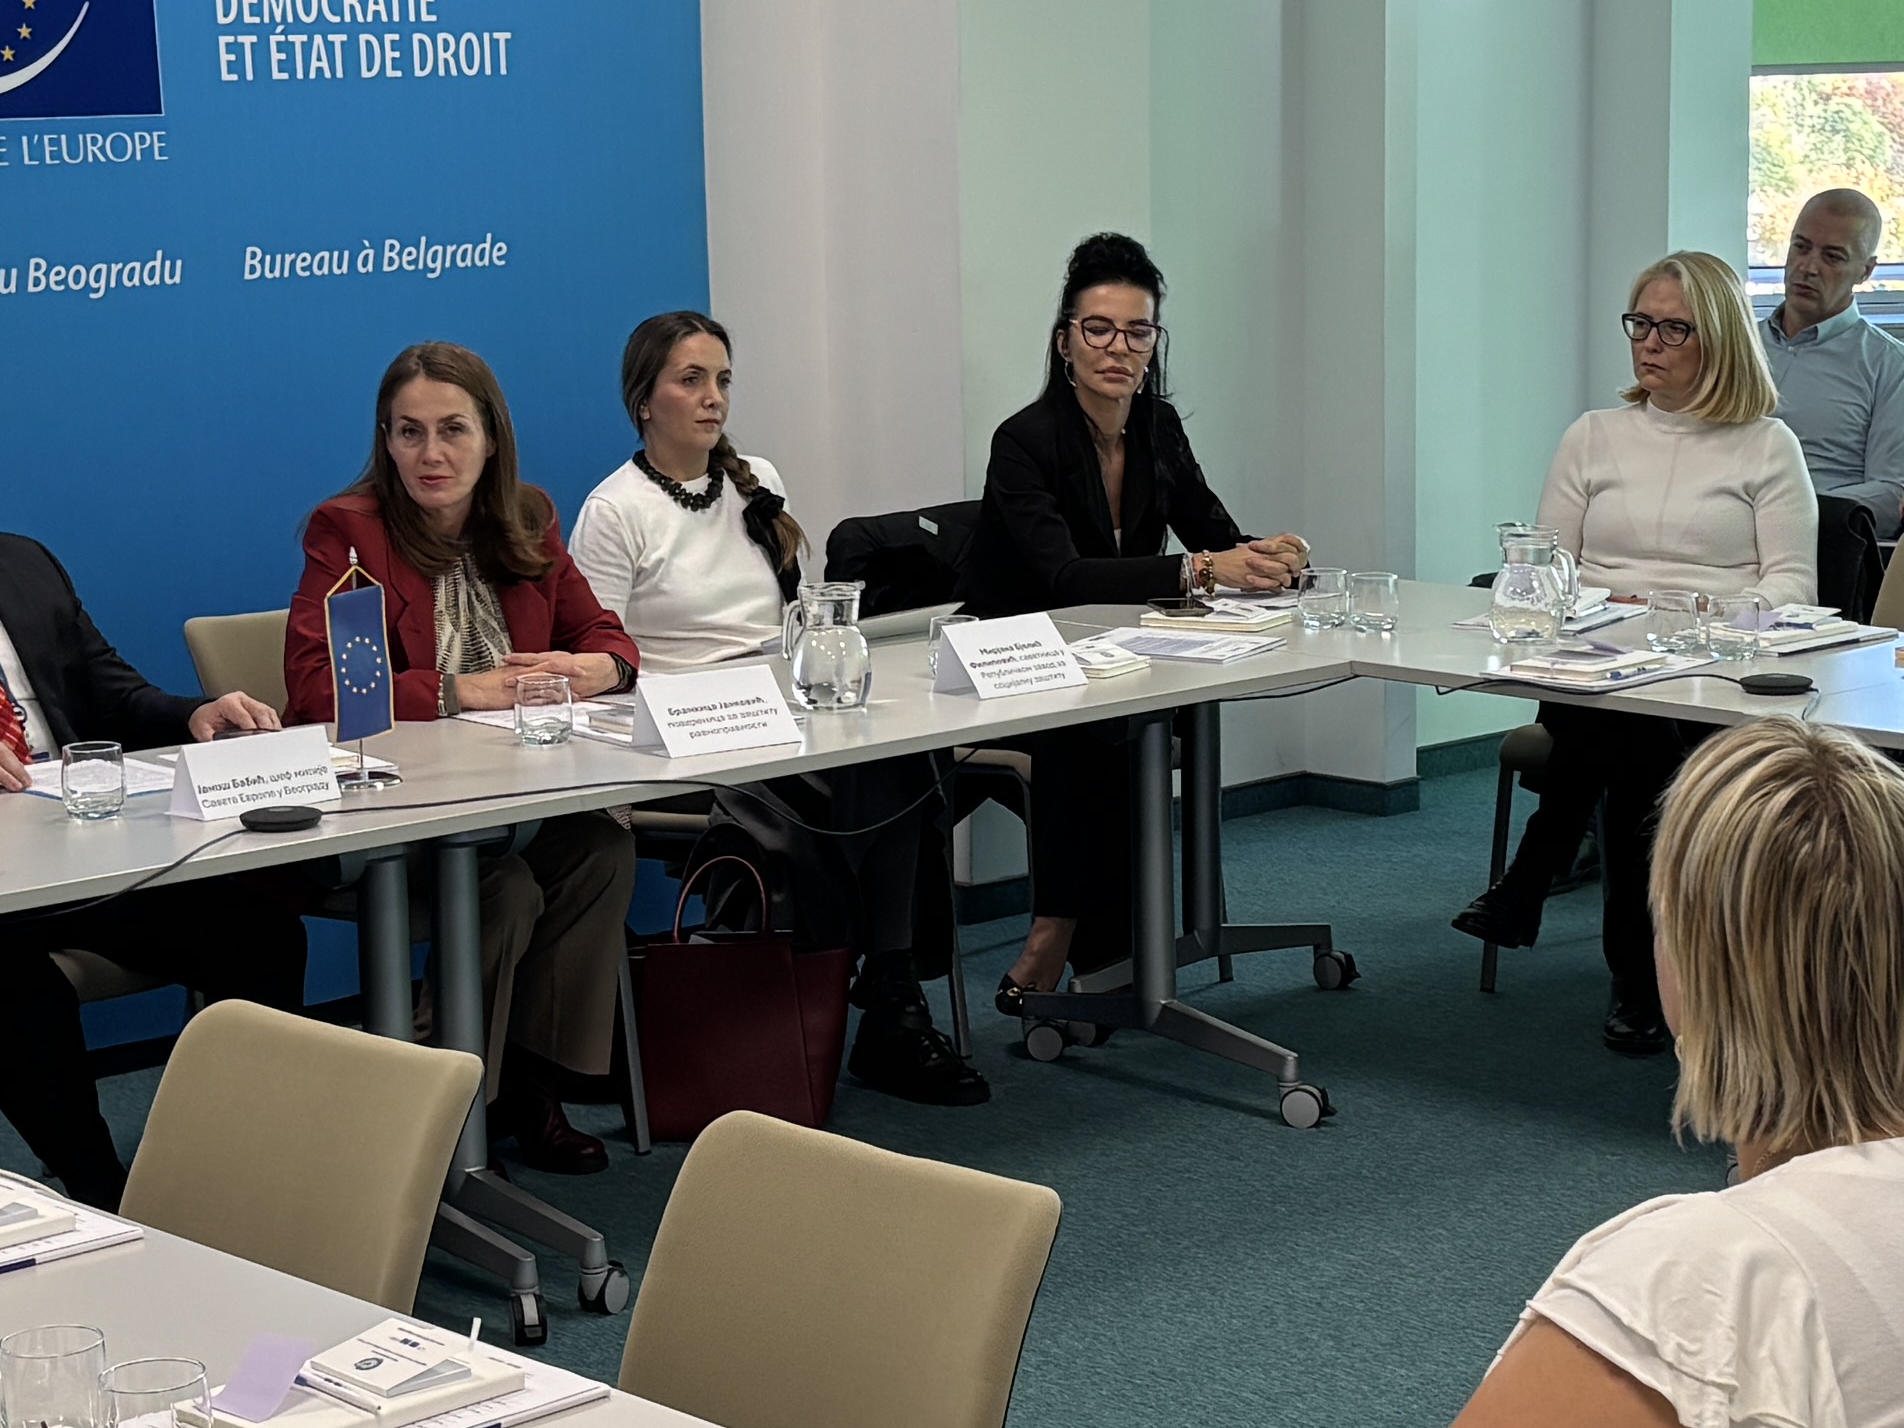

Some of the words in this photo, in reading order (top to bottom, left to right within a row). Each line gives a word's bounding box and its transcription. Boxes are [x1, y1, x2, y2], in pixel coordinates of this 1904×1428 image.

[219, 36, 257, 80] ET
[270, 25, 347, 79] ÉTAT
[359, 34, 402, 77] DE
[413, 32, 511, 76] DROIT
[22, 132, 168, 164] L'EUROPE
[0, 268, 17, 294] u
[28, 250, 182, 298] Beogradu
[244, 247, 349, 279] Bureau
[357, 240, 374, 273] à
[383, 233, 507, 278] Belgrade
